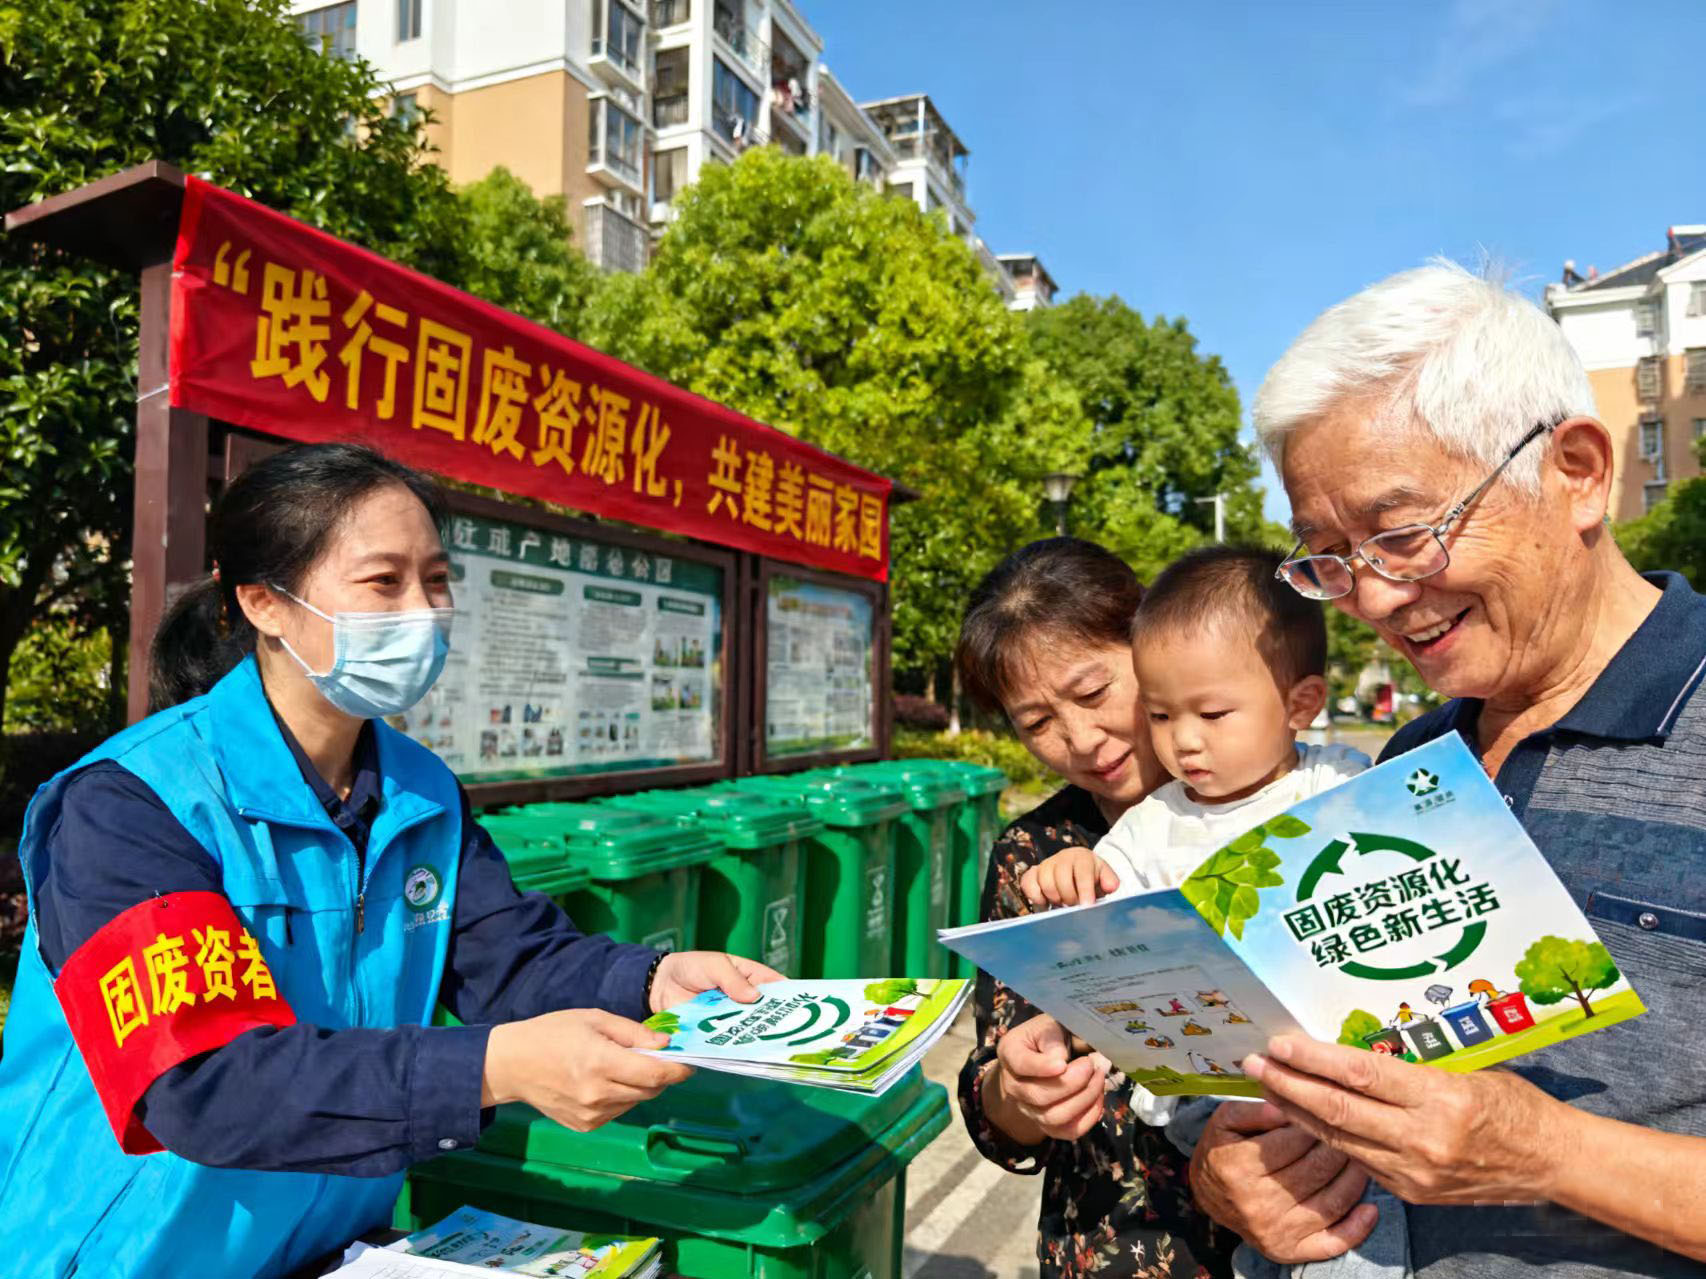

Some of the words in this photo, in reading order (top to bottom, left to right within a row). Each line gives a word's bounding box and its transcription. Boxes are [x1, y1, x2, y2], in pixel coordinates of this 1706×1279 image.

[1284, 858, 1470, 942] 固废资源化
[1311, 882, 1501, 968] 绿色新生活
